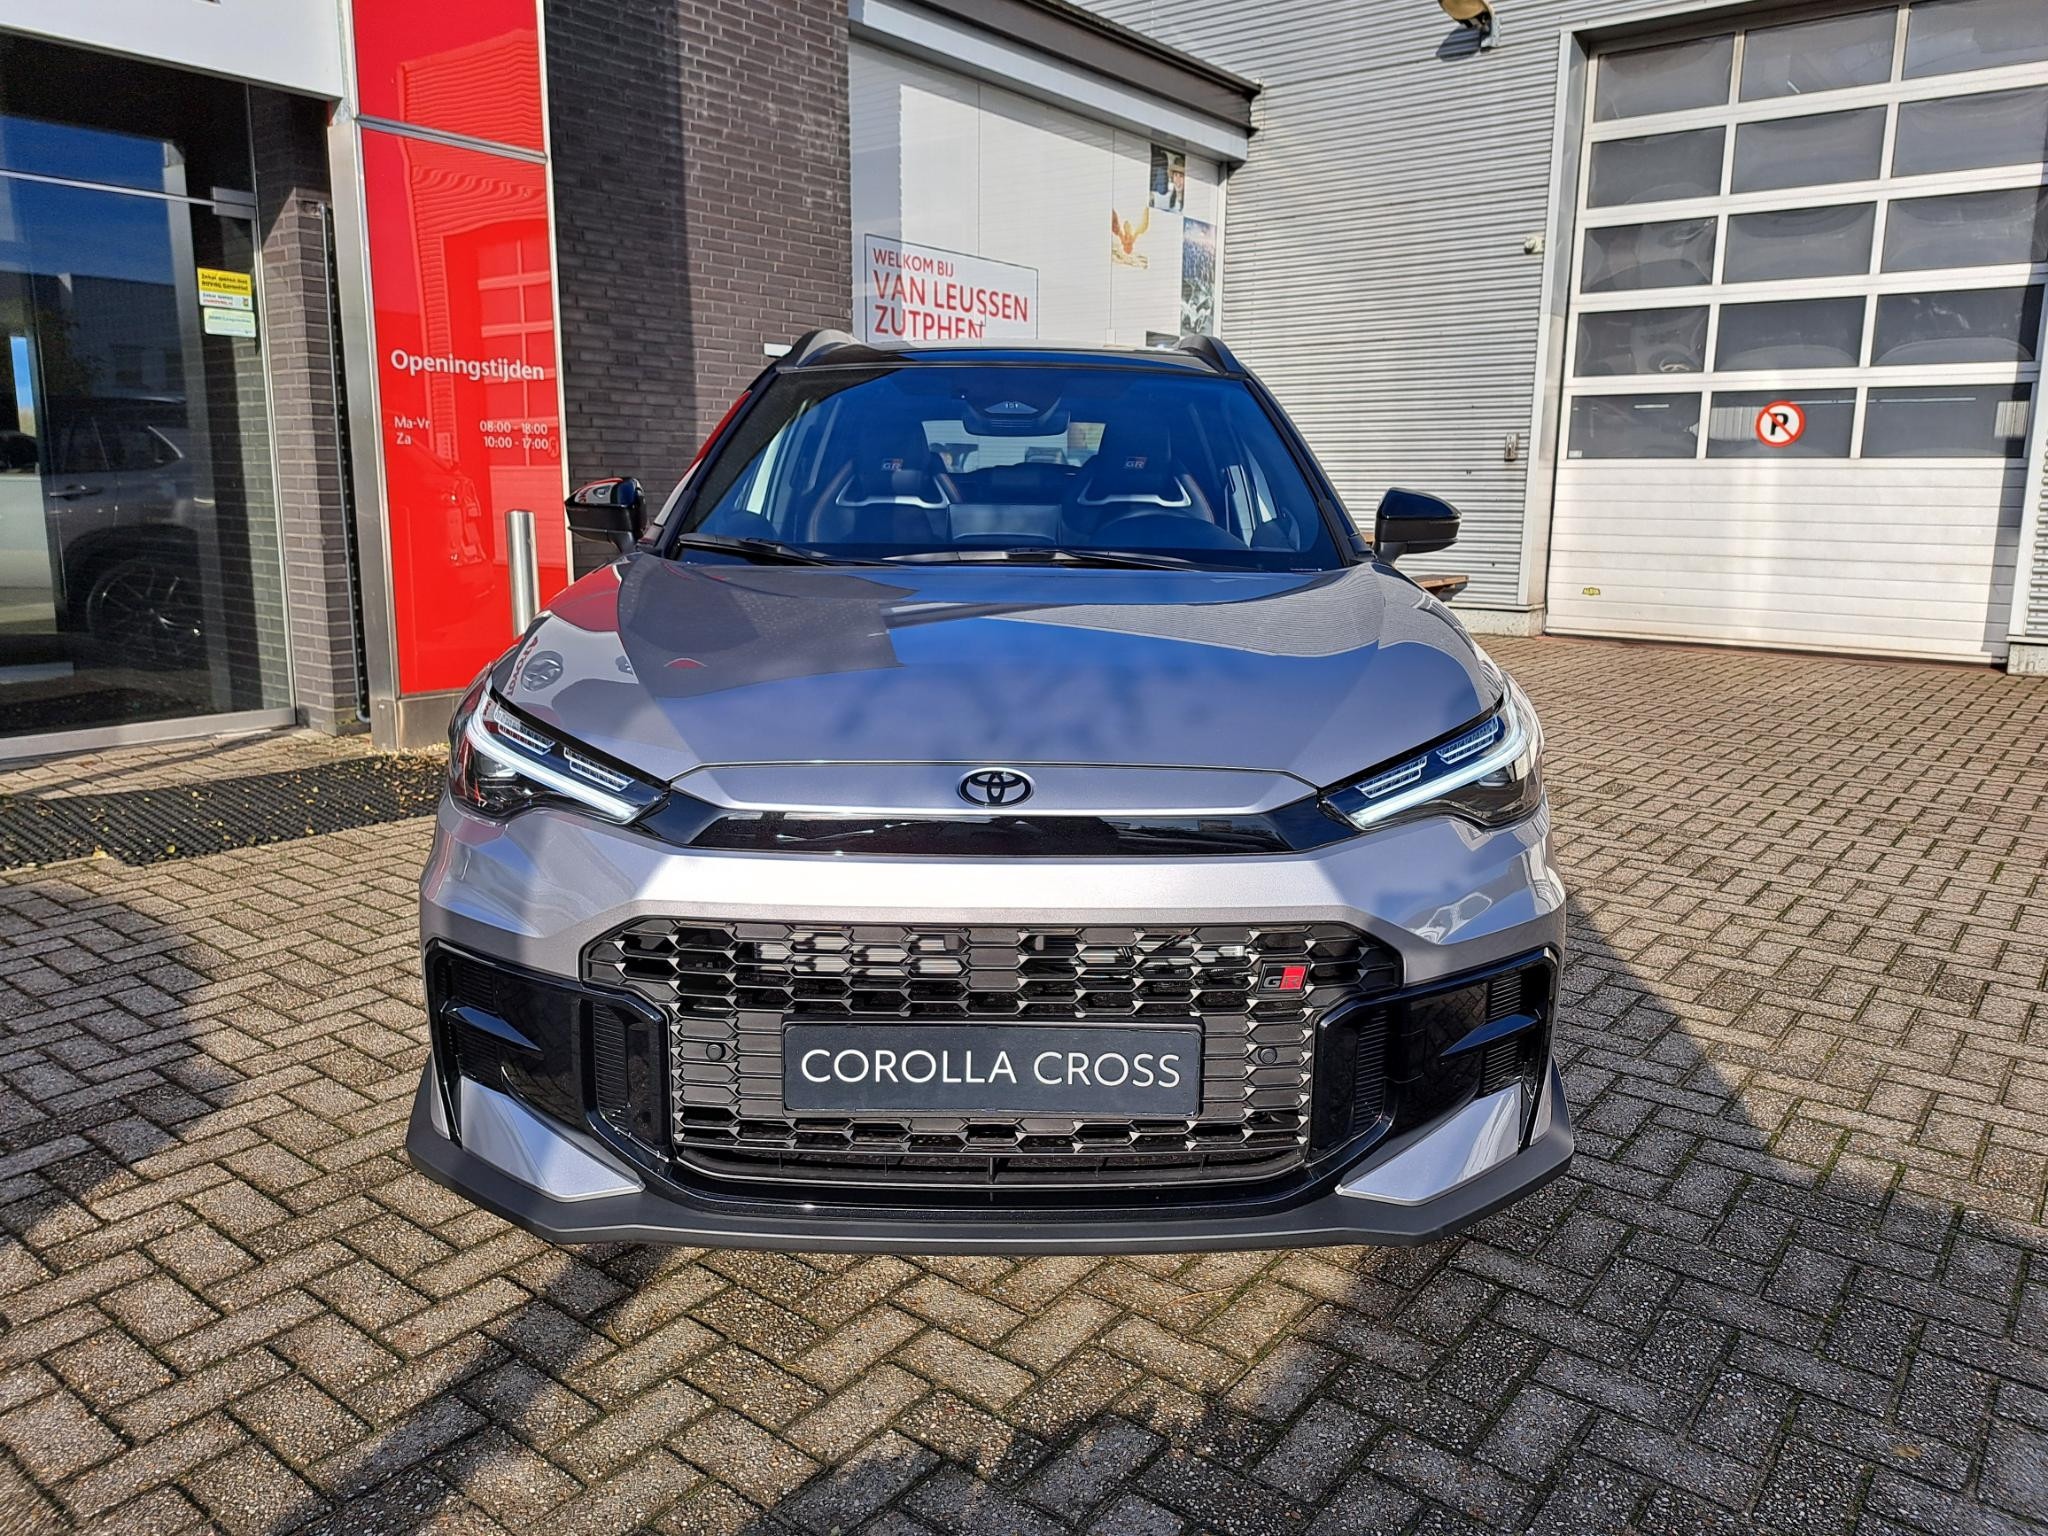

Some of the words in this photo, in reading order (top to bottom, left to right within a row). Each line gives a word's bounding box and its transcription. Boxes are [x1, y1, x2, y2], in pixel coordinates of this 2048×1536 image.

[872, 247, 934, 274] WELKOM
[937, 260, 954, 278] BIJ
[872, 269, 926, 307] VAN
[934, 280, 1029, 322] LEUSSEN
[874, 304, 984, 341] ZUTPHEN
[390, 348, 545, 383] Openingstijden
[394, 415, 431, 430] Ma-Vr
[479, 420, 511, 434] 08:00
[521, 422, 548, 436] 18:00
[396, 432, 412, 445] Za
[484, 436, 512, 449] 10:00
[801, 1048, 1017, 1083] COROLLA
[1033, 1050, 1181, 1088] CROSS
